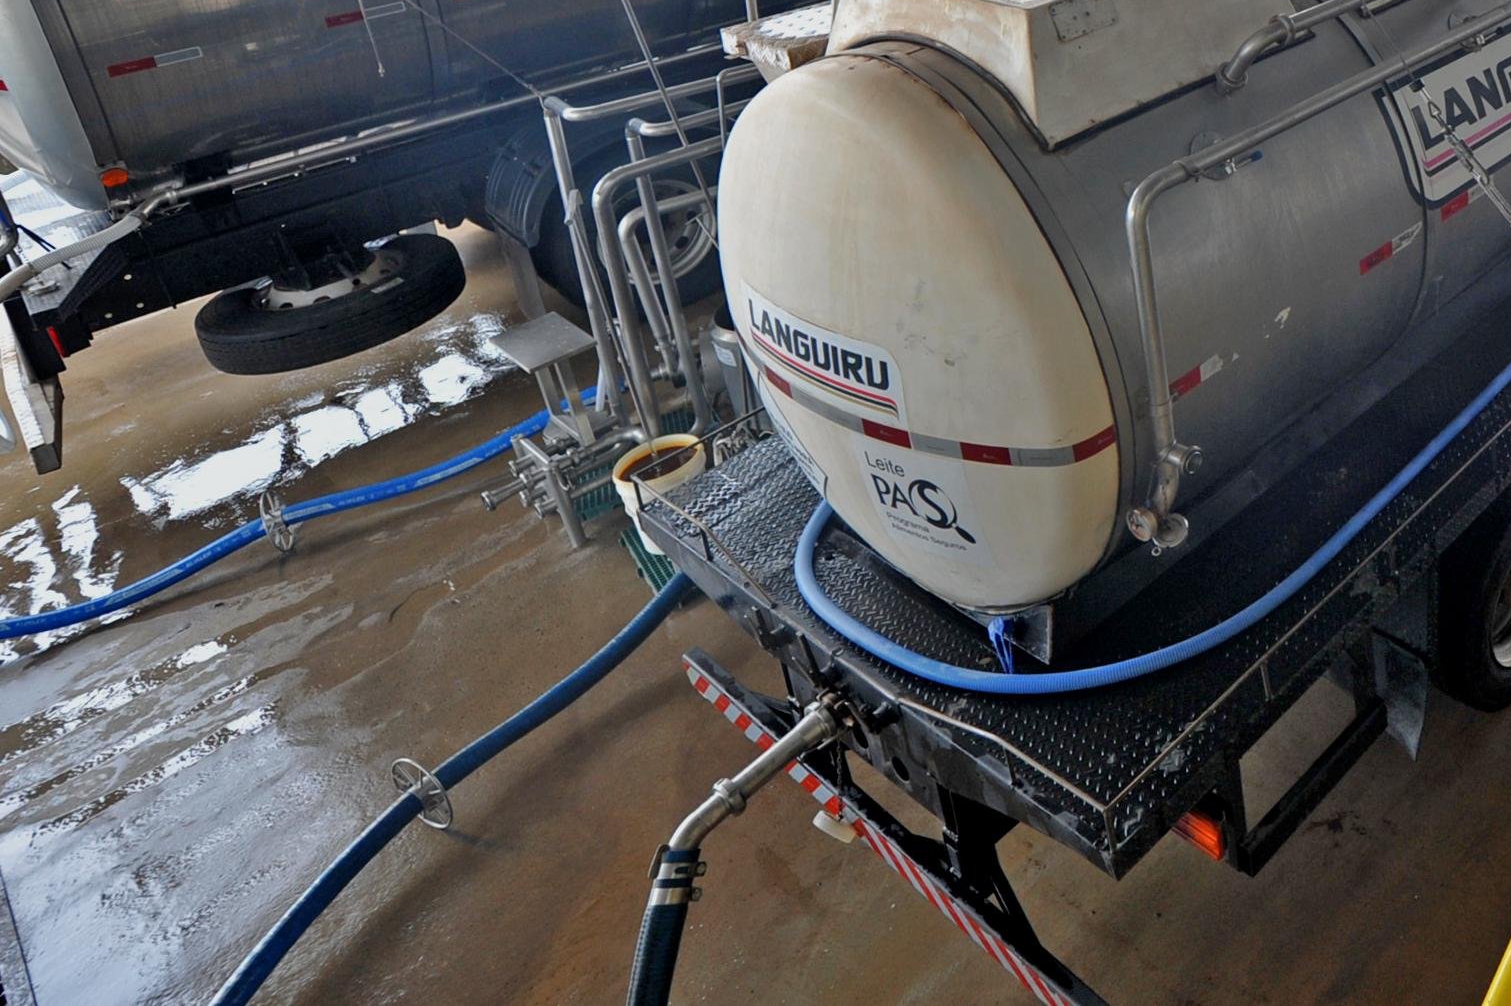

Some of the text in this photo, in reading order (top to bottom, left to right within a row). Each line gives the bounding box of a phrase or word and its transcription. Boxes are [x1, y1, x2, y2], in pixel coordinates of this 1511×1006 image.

[748, 298, 890, 392] LANGUIRU
[864, 450, 905, 477] Leite
[871, 474, 957, 529] PAS
